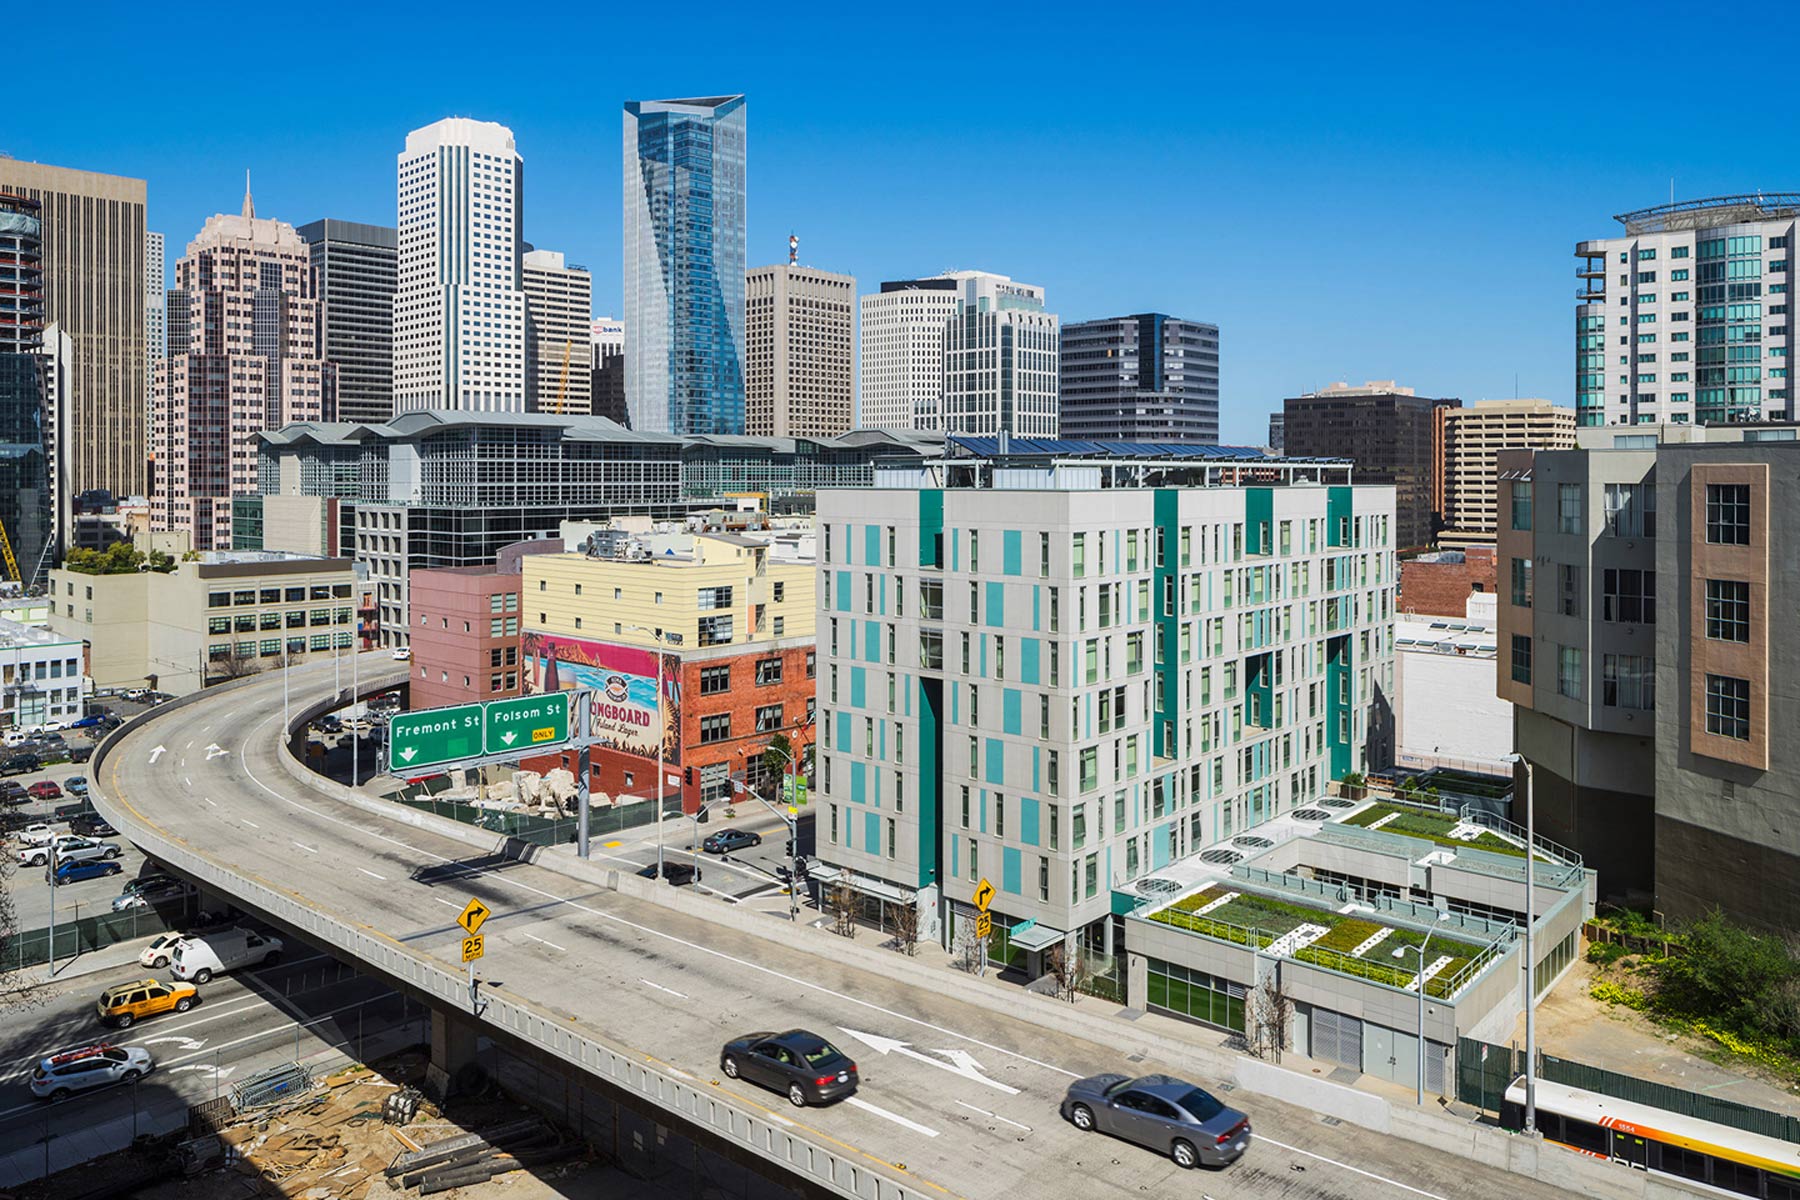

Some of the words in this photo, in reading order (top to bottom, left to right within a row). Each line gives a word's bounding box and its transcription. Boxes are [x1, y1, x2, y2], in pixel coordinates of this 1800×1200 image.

[495, 709, 540, 723] Folsom
[547, 704, 561, 716] St
[591, 701, 650, 727] ONGBOARD
[396, 719, 457, 738] Fremont
[464, 716, 480, 728] St
[533, 730, 553, 740] ONLY
[618, 723, 638, 738] Lager
[978, 915, 990, 930] 25
[465, 938, 482, 954] 25
